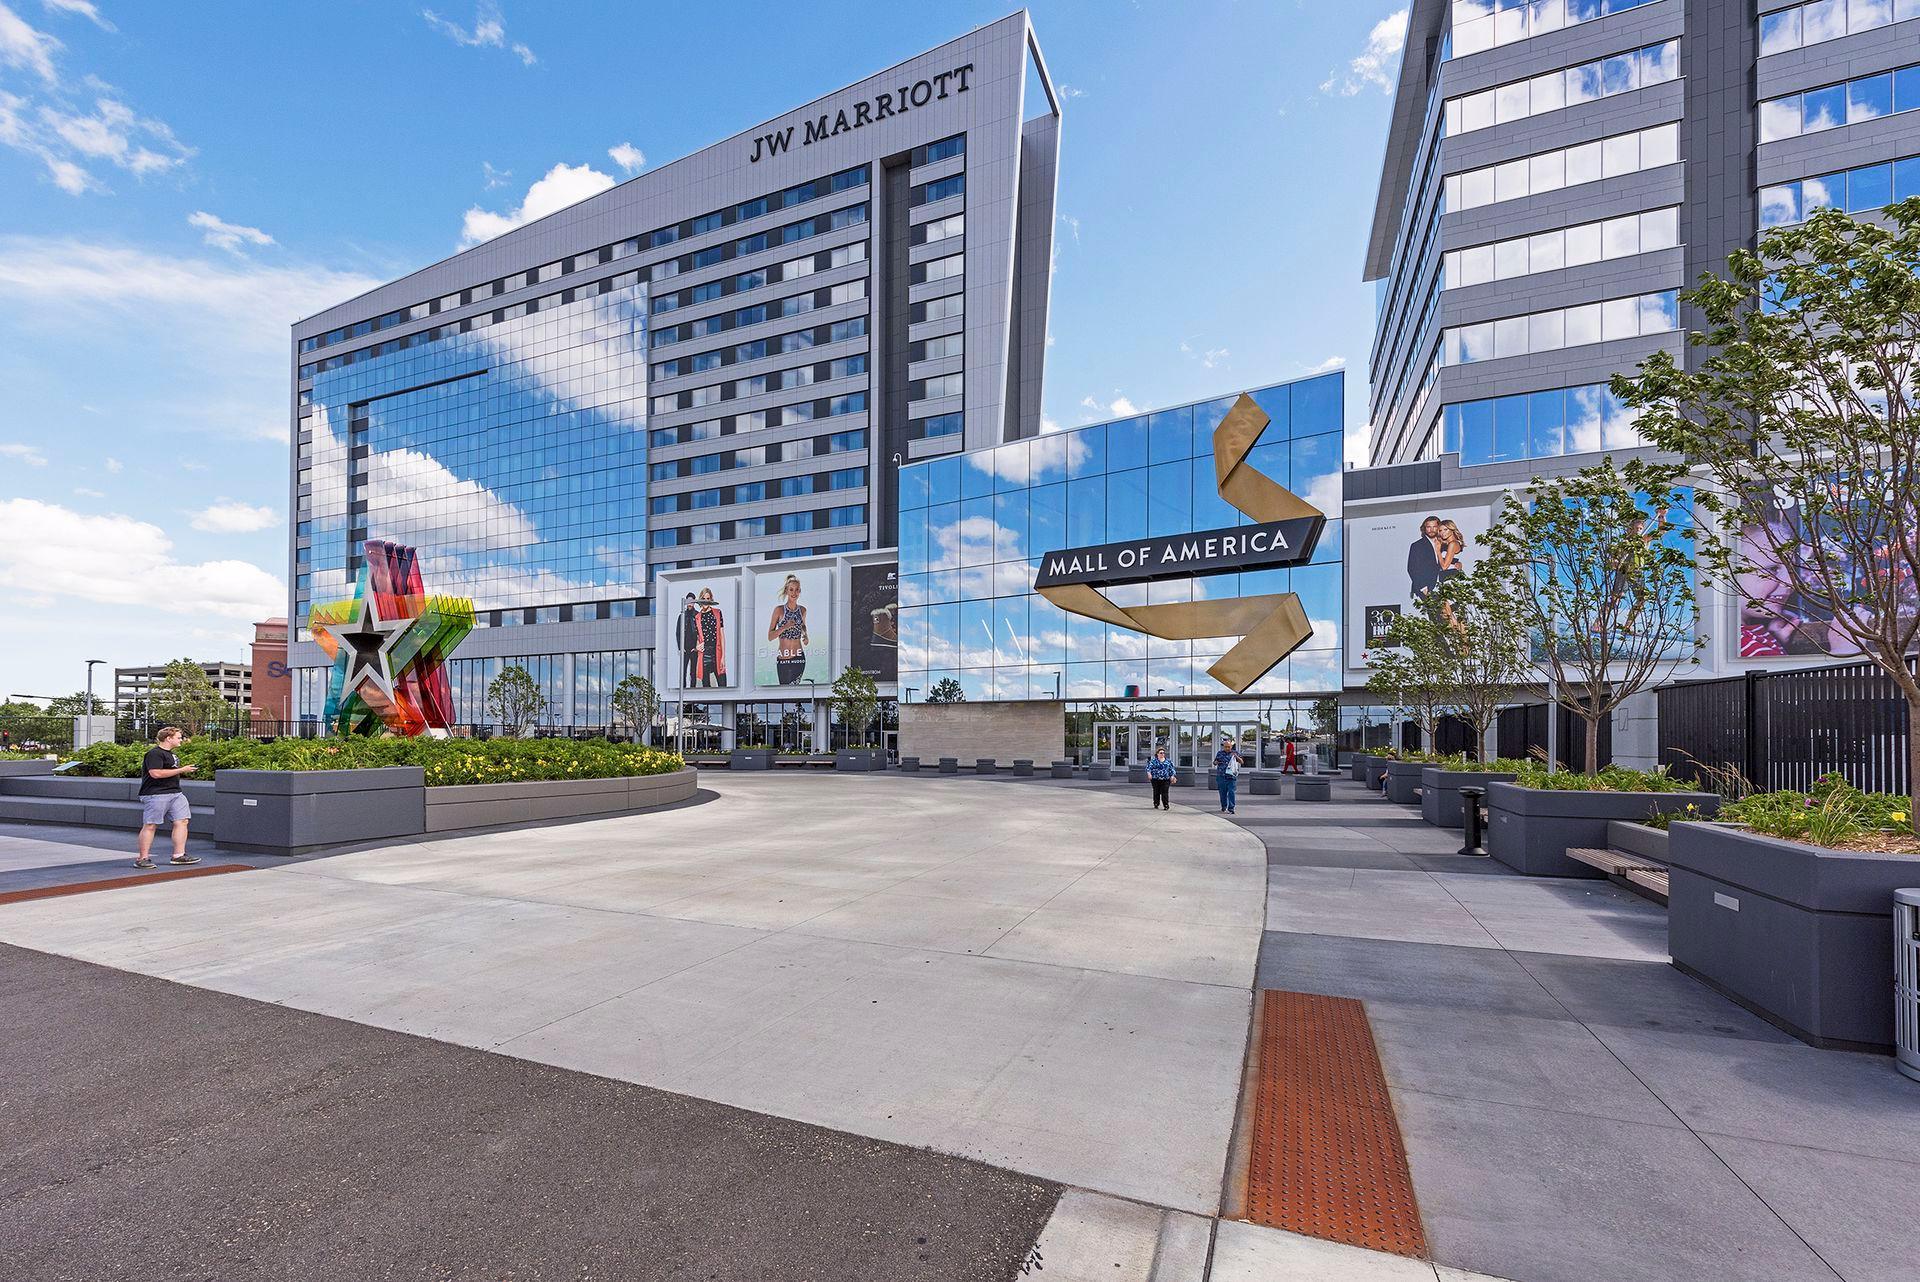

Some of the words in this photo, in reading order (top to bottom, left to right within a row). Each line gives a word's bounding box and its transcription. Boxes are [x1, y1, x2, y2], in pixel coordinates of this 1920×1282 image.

[750, 126, 795, 163] JW
[803, 63, 974, 146] MARRIOTT
[1049, 552, 1108, 577] MALL
[1117, 547, 1151, 568] OF
[1160, 529, 1289, 564] AMERICA
[770, 648, 826, 657] FABLEICS
